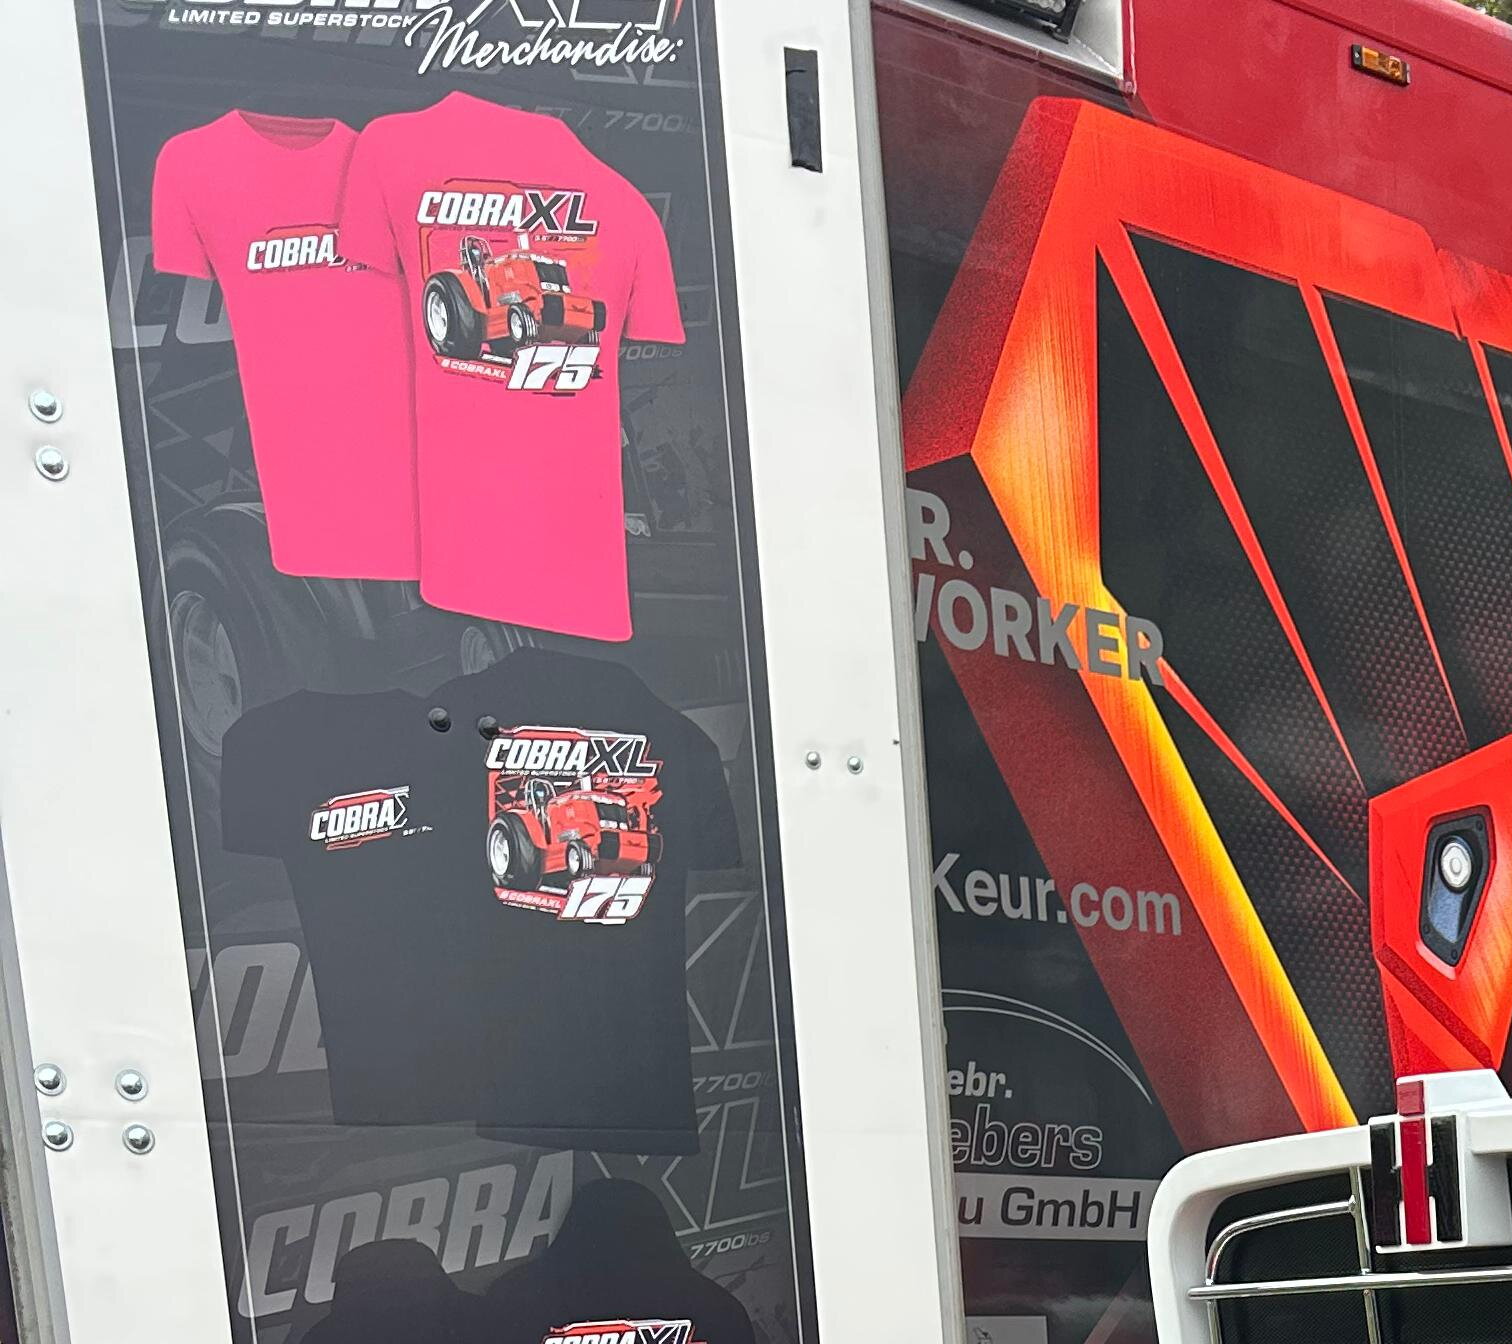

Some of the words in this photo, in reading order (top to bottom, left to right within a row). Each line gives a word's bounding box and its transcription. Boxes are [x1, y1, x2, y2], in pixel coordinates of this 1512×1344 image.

[167, 8, 260, 26] LIMITED
[403, 6, 685, 76] Merchandise:
[246, 231, 344, 271] COBRA
[506, 345, 601, 391] 175
[560, 876, 652, 919] 175
[1000, 1185, 1142, 1230] GmbH
